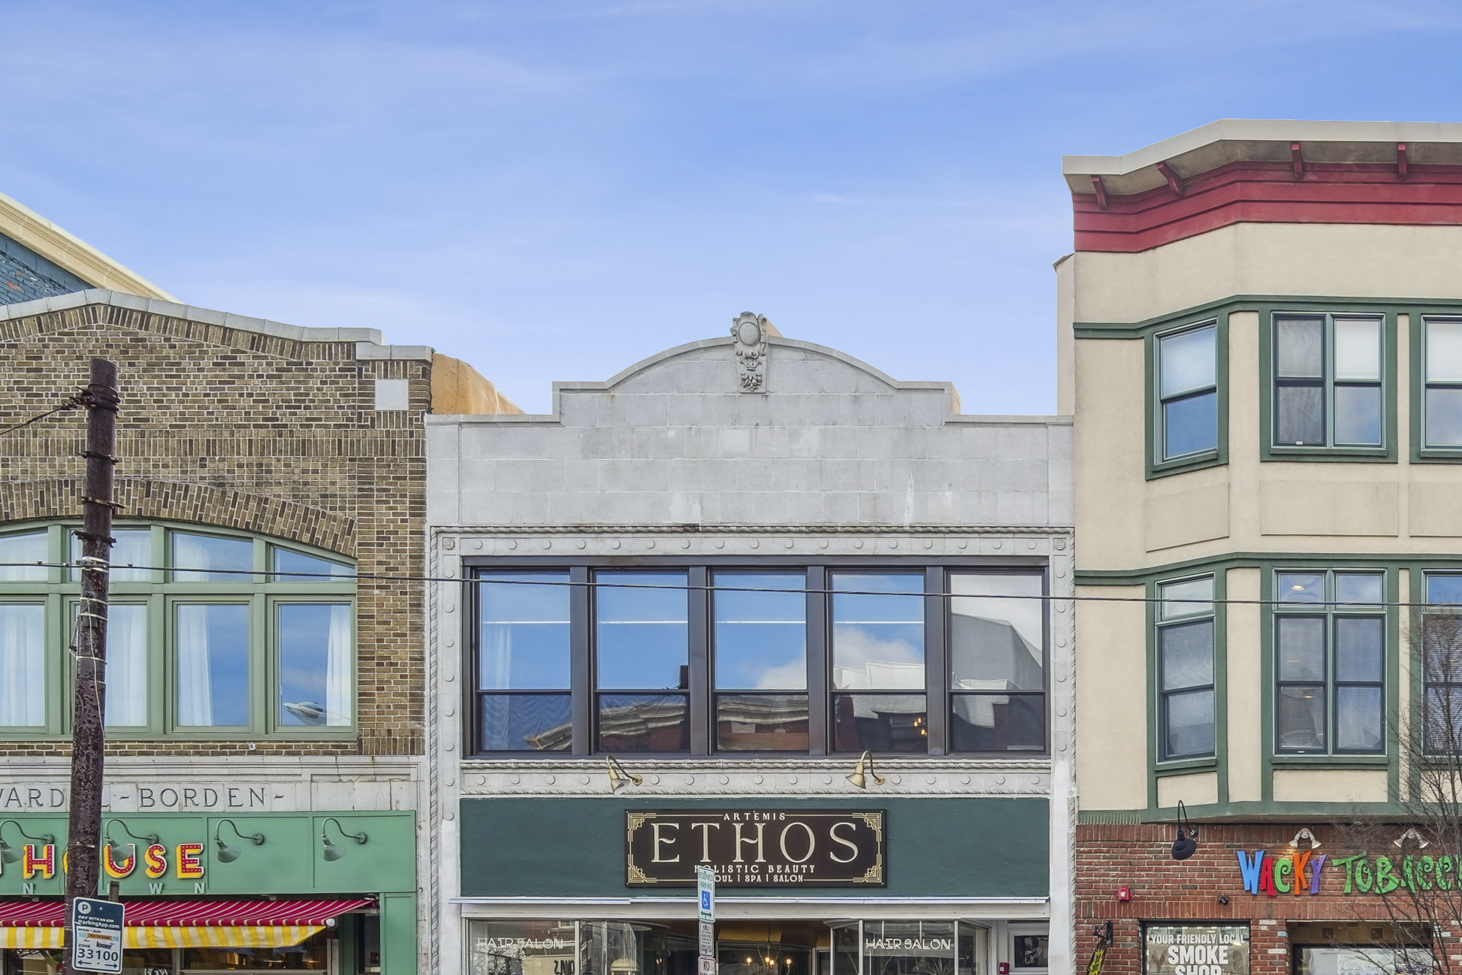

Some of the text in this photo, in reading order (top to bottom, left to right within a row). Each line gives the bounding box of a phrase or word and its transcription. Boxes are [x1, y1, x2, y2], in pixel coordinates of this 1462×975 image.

[0, 788, 65, 808] ARD
[140, 788, 266, 808] BORDEN
[723, 812, 786, 821] ARTEMIS
[650, 821, 859, 863] ETHOS
[23, 843, 204, 879] HUSE
[768, 864, 815, 874] BEAUTY
[1236, 850, 1328, 897] WACKY
[713, 874, 804, 883] OUL SPA SALON
[78, 920, 120, 929] ParkingApp.com
[477, 937, 564, 950] HAIR SALON
[865, 938, 951, 950] HAIR SALON
[1151, 934, 1245, 944] YOUR FRIENDLY LOCAL
[78, 948, 119, 962] 33100
[1167, 945, 1229, 965] SMOKE
